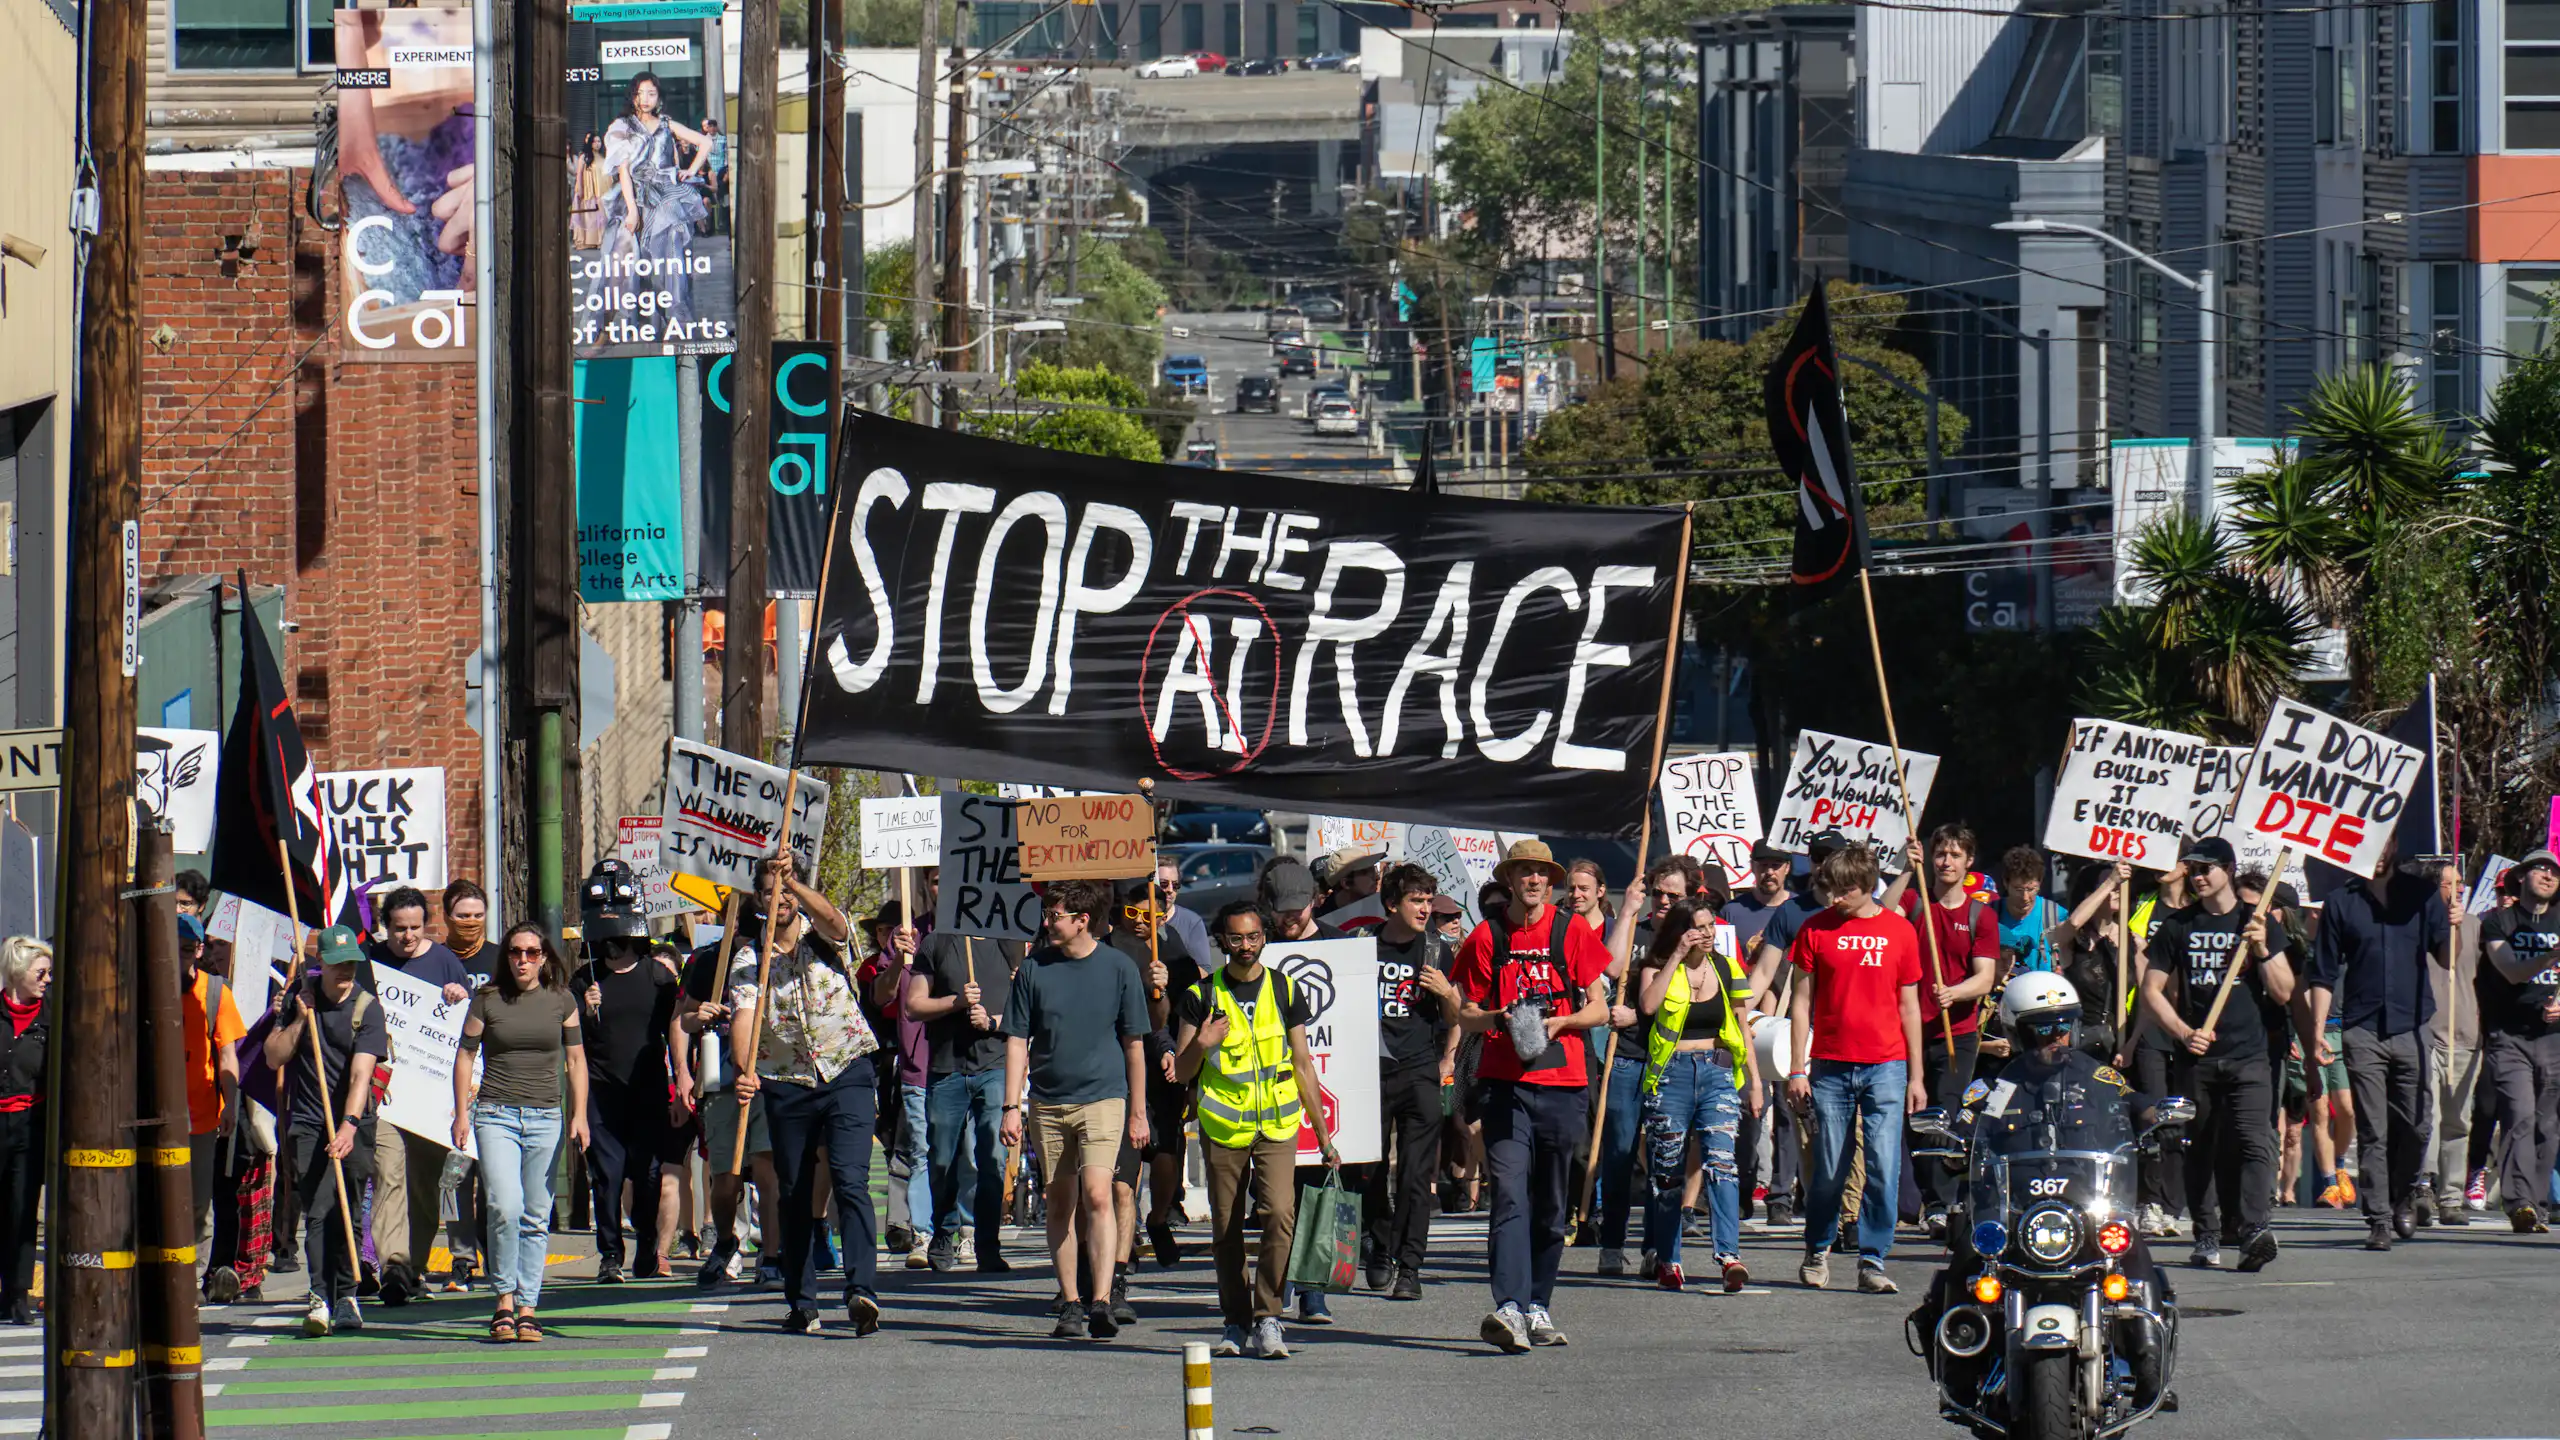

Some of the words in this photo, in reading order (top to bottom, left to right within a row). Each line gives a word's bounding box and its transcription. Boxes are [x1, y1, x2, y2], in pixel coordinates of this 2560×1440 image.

[673, 7, 698, 15] Design
[394, 51, 473, 62] EXPERIMENT
[606, 45, 686, 57] EXPRESSION
[347, 215, 394, 275] C
[570, 249, 711, 279] California
[572, 286, 673, 317] College
[605, 318, 655, 343] the
[663, 316, 728, 341] Arts
[682, 346, 735, 355] 415-431-2950
[1170, 501, 1320, 591] THE
[588, 572, 624, 590] the
[631, 571, 677, 588] Arts
[827, 467, 1152, 716] STOP
[1288, 541, 1657, 772] RACE
[1152, 613, 1264, 754] AI
[2074, 725, 2109, 753] IF
[2112, 730, 2204, 767] ANYONE
[2273, 708, 2316, 753] I
[2317, 721, 2417, 788] DON'T
[0, 743, 62, 778] NT
[678, 748, 752, 798] THE
[1668, 758, 1743, 790] STOP
[1803, 736, 1848, 778] You
[1850, 745, 1911, 787] Said
[2093, 759, 2172, 786] BUILDS
[1787, 772, 1826, 800] You
[2109, 784, 2139, 805] IT
[2259, 751, 2362, 809] WANT
[2357, 781, 2403, 823] TO
[676, 785, 775, 836] WINNING
[1026, 803, 1061, 827] NO
[1081, 799, 1134, 822] UNDO
[1684, 792, 1736, 811] THE
[1809, 797, 1878, 830] PUSH
[329, 814, 407, 846] HIS
[874, 811, 908, 828] TIME
[913, 809, 936, 824] OUT
[1061, 824, 1089, 838] FOR
[1676, 812, 1746, 834] RACE
[1781, 817, 1813, 846] The
[2254, 791, 2366, 864] DIE
[620, 828, 632, 842] NO
[2089, 824, 2148, 860] DIES
[632, 849, 654, 860] ANY
[669, 831, 706, 857] IS
[709, 844, 742, 872] NOT
[887, 838, 916, 860] U.S.
[1027, 838, 1146, 868] EXTINCTION
[1703, 841, 1745, 868] AI
[951, 847, 1020, 884] THE
[953, 886, 1036, 936] RAC
[1837, 936, 1889, 950] STOP
[2189, 932, 2240, 949] STOP
[2514, 932, 2559, 949] STOP
[1529, 964, 1550, 980] AI
[1860, 951, 1883, 967] AI
[2188, 951, 2227, 968] THE
[432, 1003, 450, 1021] &
[1382, 1001, 1410, 1018] CE
[418, 1024, 446, 1043] race
[408, 1043, 427, 1056] never
[427, 1052, 445, 1066] going
[446, 1058, 453, 1067] to
[429, 1067, 449, 1080] safety
[2029, 1178, 2070, 1196] 367
